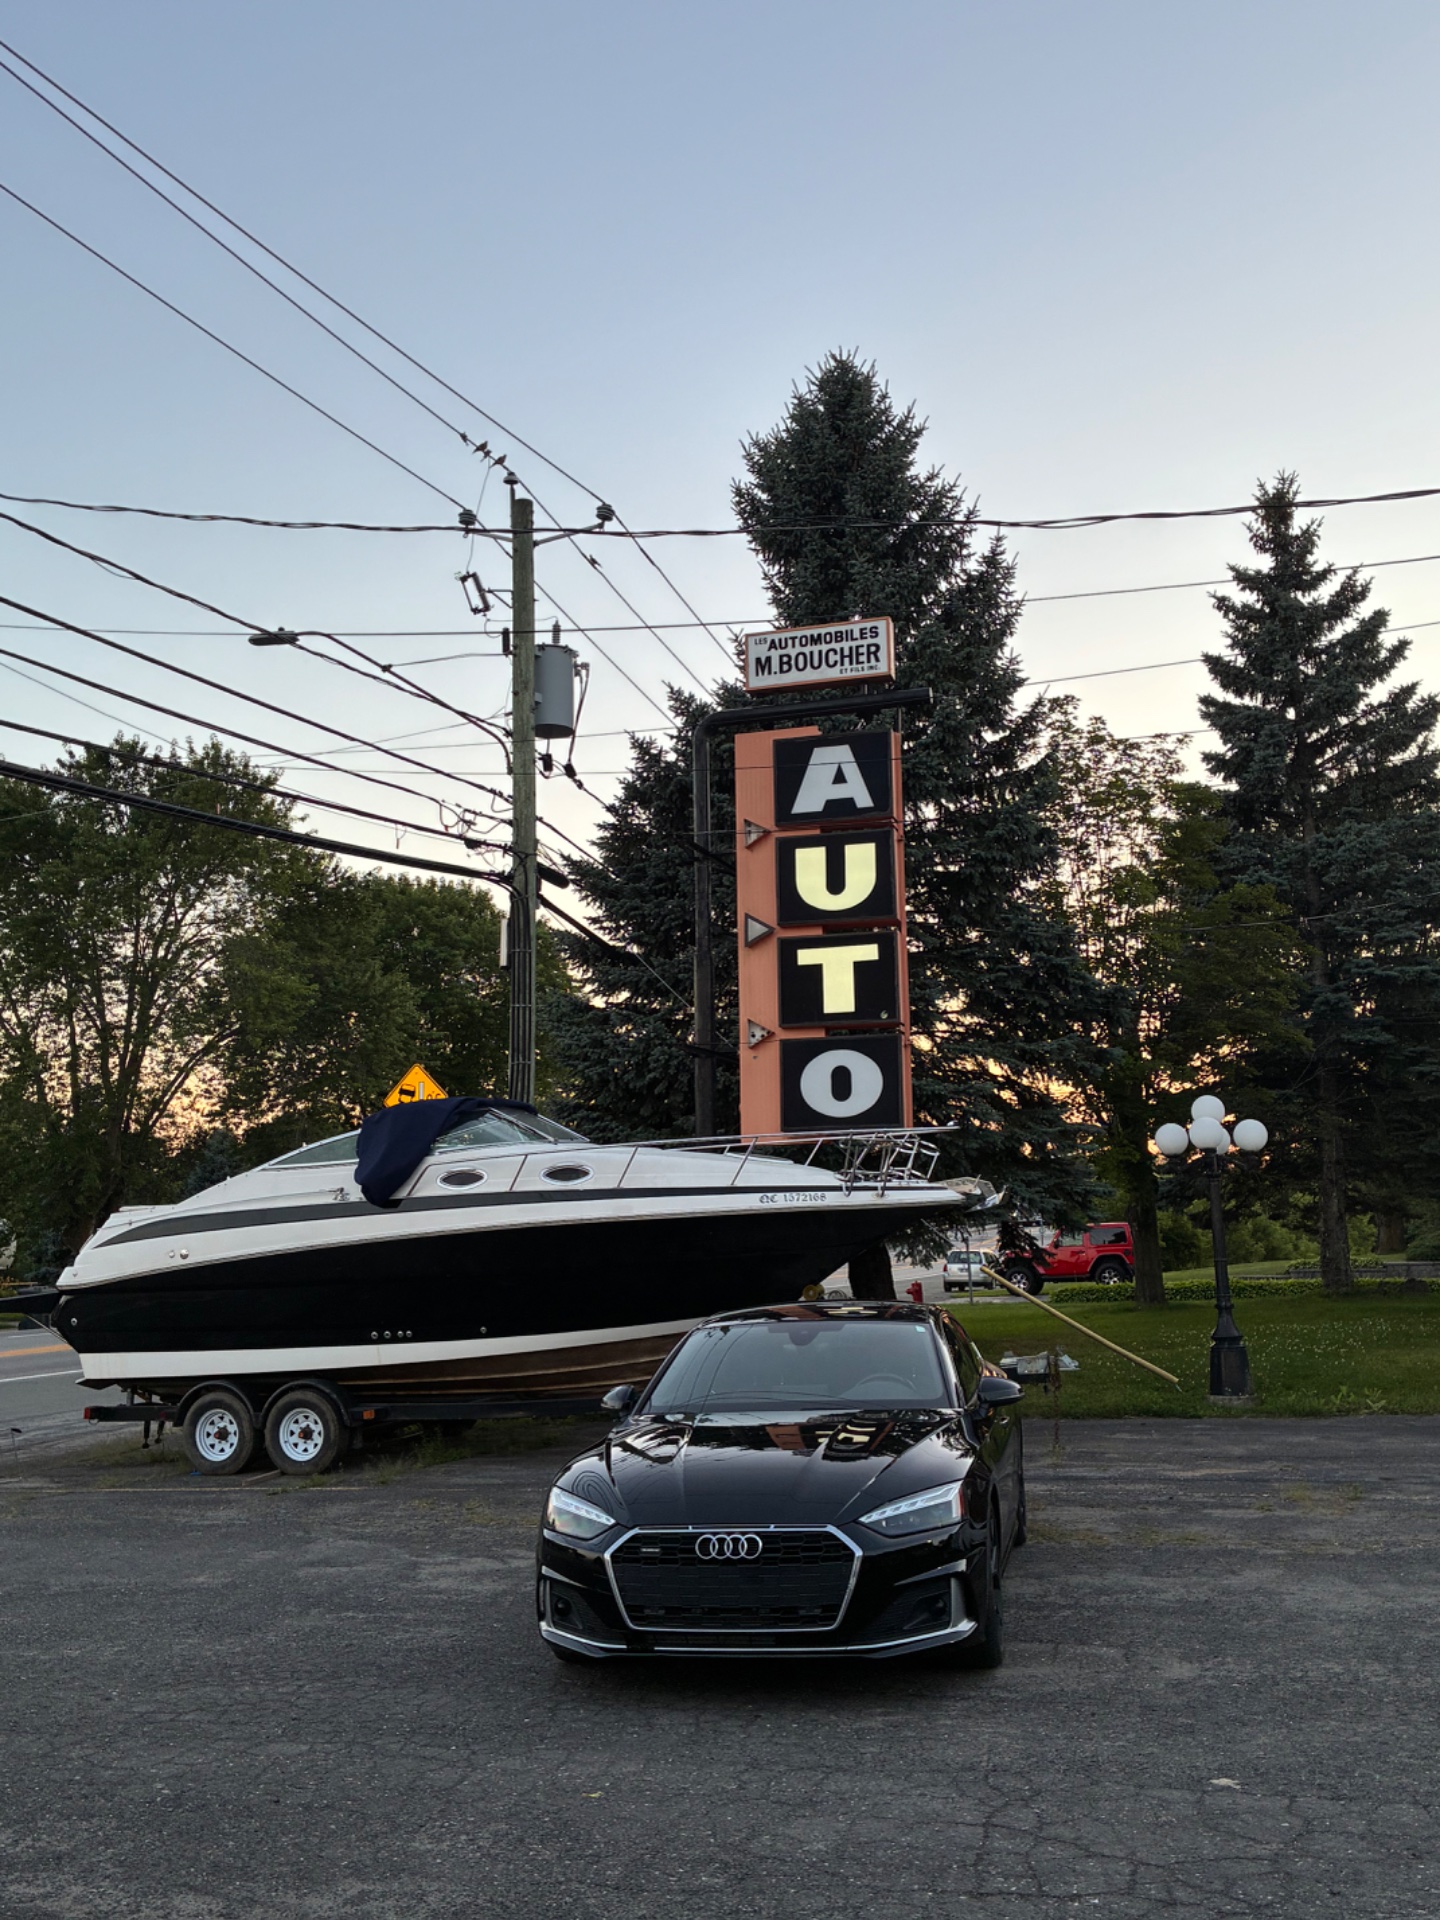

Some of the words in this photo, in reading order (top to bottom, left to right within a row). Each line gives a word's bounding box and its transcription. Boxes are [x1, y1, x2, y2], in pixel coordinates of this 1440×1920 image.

[754, 637, 768, 646] LES
[768, 626, 879, 651] AUTOMOBILES
[791, 744, 883, 1118] AUTO
[759, 1194, 778, 1204] QC
